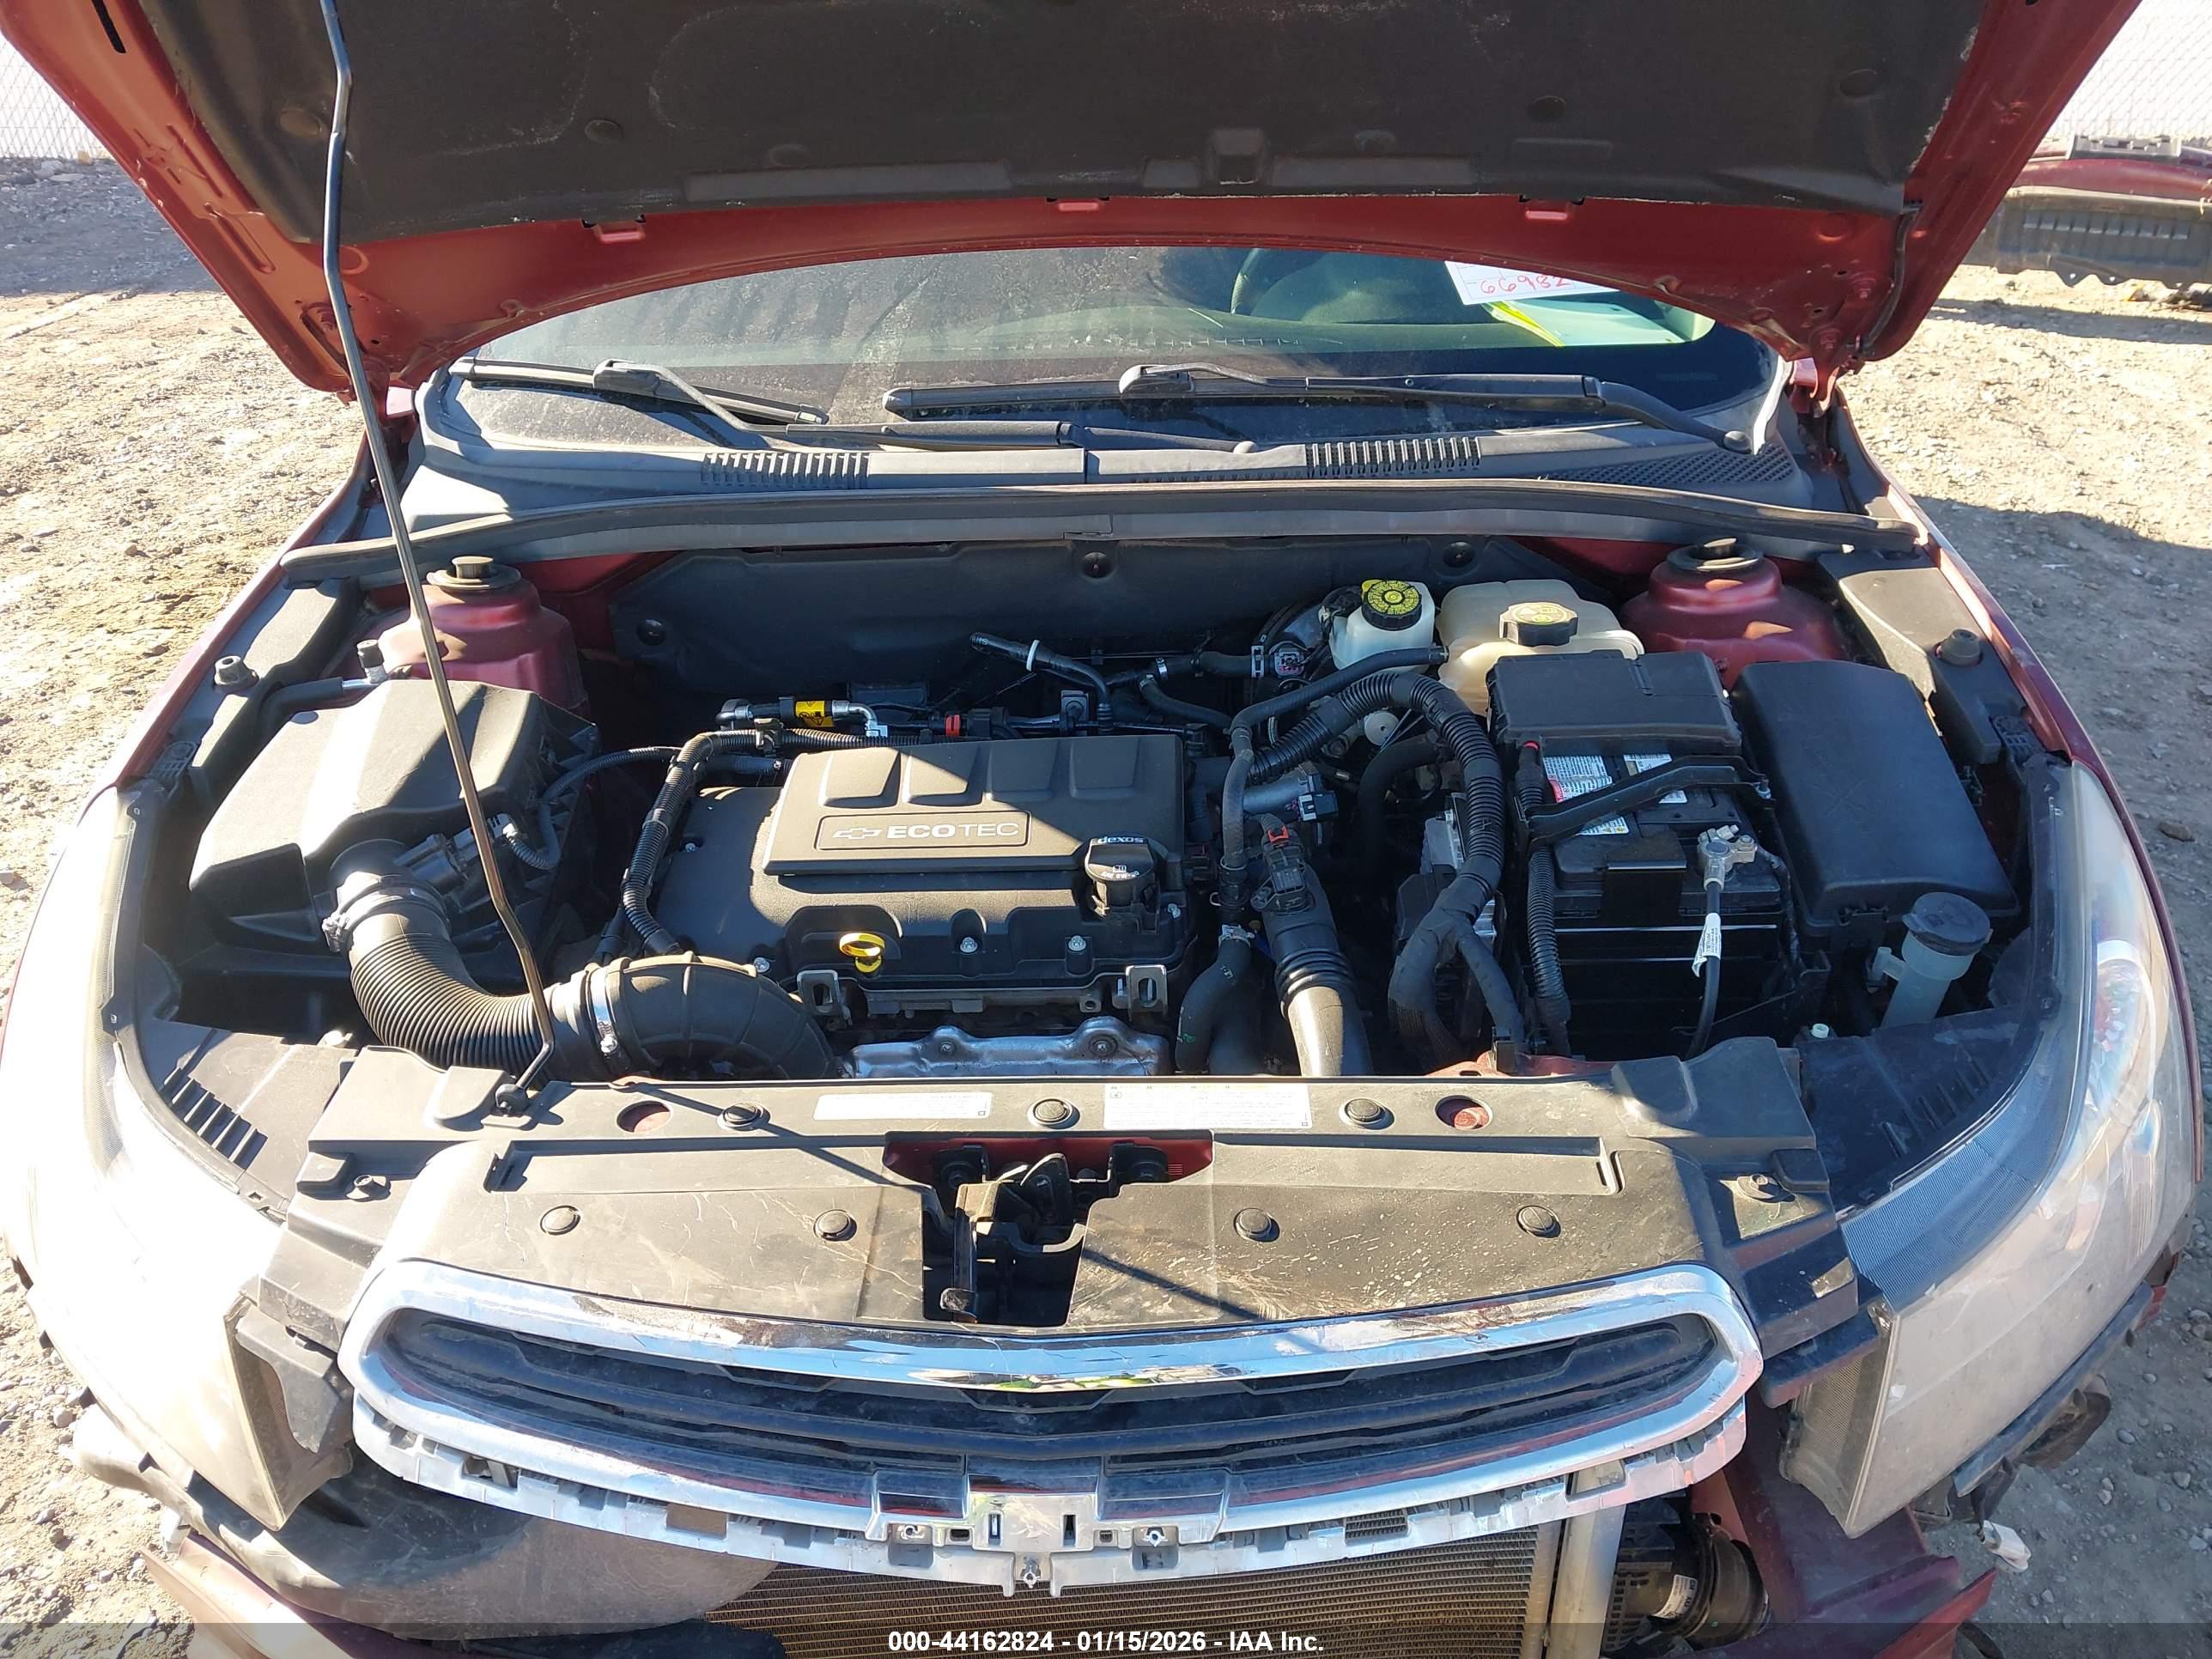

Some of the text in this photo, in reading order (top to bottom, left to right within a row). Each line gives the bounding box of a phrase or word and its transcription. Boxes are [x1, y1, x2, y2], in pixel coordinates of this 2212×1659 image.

[1480, 275, 1571, 294] 66982
[887, 822, 1019, 839] ECOTEC
[1097, 836, 1145, 844] dexos
